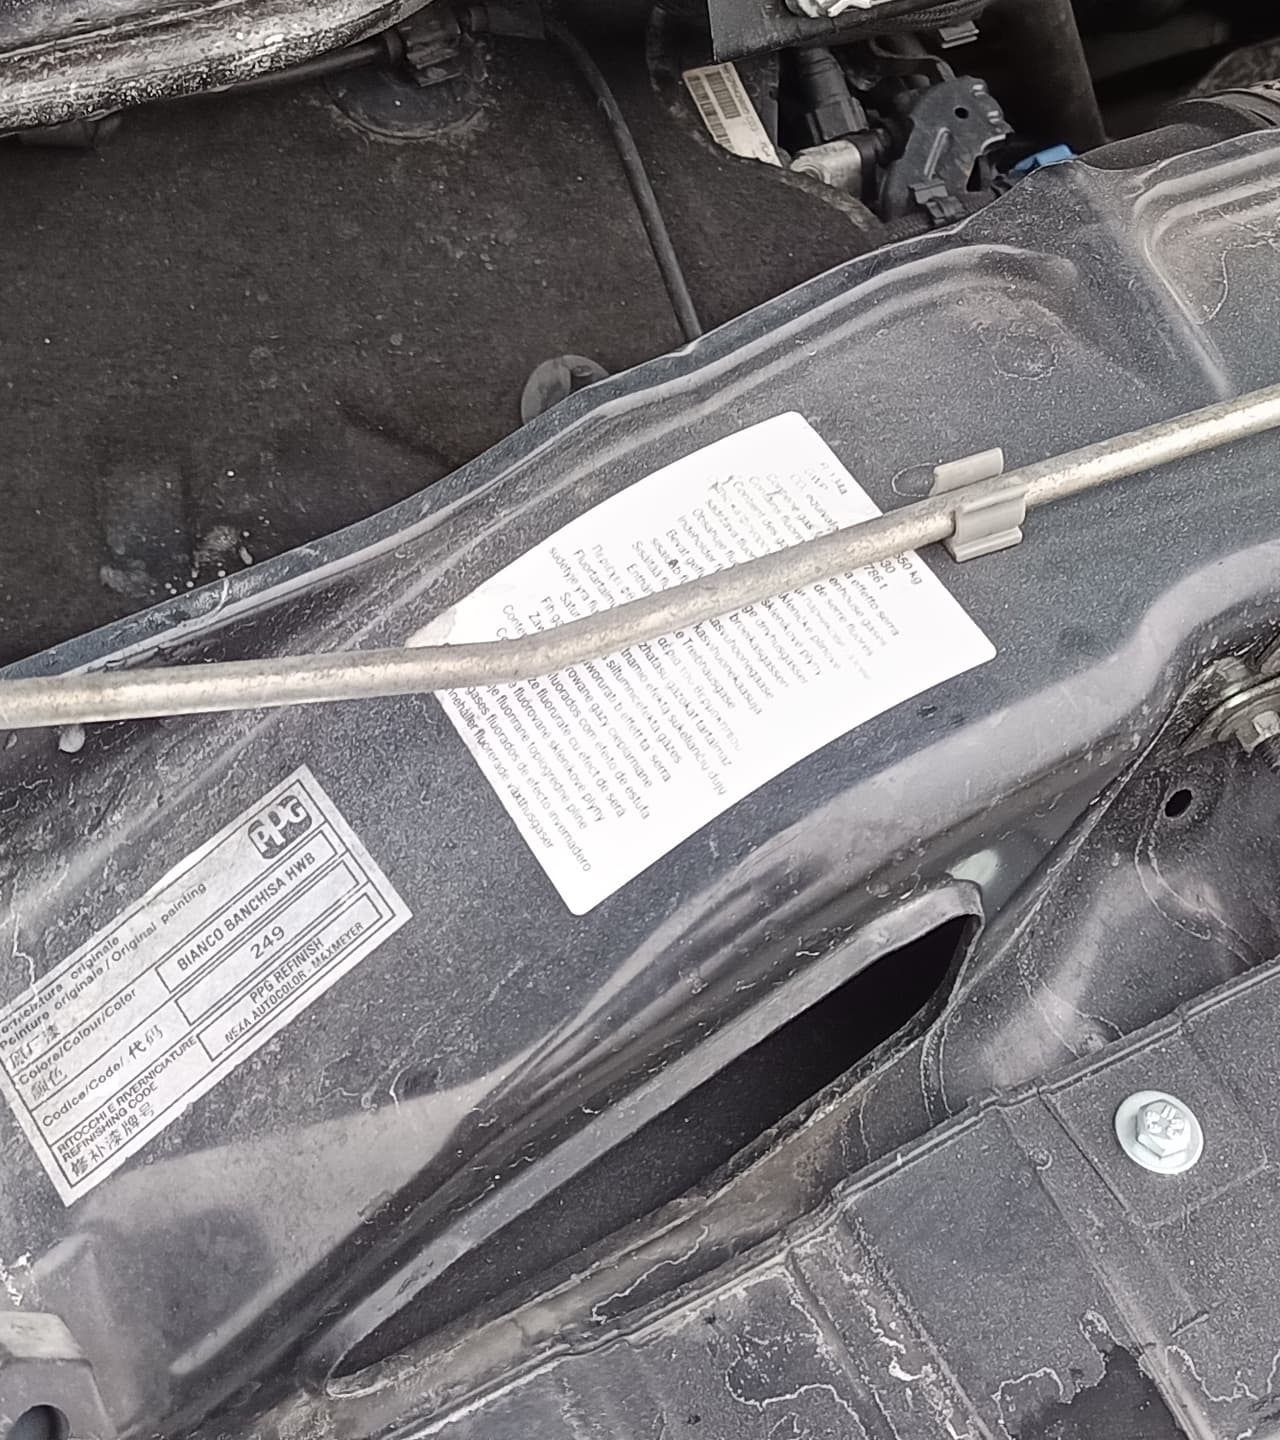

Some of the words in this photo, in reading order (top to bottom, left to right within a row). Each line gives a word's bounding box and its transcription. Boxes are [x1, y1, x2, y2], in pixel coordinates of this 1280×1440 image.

[827, 575, 866, 618] enhouse
[905, 569, 925, 587] kg
[444, 684, 481, 731] nnehåller
[563, 664, 595, 704] rowane
[463, 684, 492, 717] gases
[484, 713, 523, 762] fluorados
[515, 760, 532, 777] de
[594, 775, 612, 793] de
[613, 768, 631, 786] de
[248, 794, 313, 860] PPG
[174, 925, 225, 972] BIANCO
[221, 874, 287, 933] BANCHISA
[283, 849, 317, 881] HWB
[248, 922, 287, 960] 249
[51, 962, 106, 1013] originale
[109, 919, 158, 964] Original
[158, 880, 208, 926] painting
[67, 933, 122, 982] originale
[248, 978, 275, 1005] PPG
[271, 935, 325, 985] REFINISH
[222, 1014, 252, 1044] NEXA
[249, 967, 308, 1021] AUTOCOLOR
[309, 919, 365, 970] MAXMEYER
[16, 983, 139, 1090] Colore/Colour/Color
[56, 1108, 108, 1156] RITOCCHI
[106, 1102, 117, 1114] E
[114, 1034, 197, 1107] RIVERNICIATURE
[61, 1104, 128, 1165] REFINISHING
[126, 1079, 159, 1111] CODE
